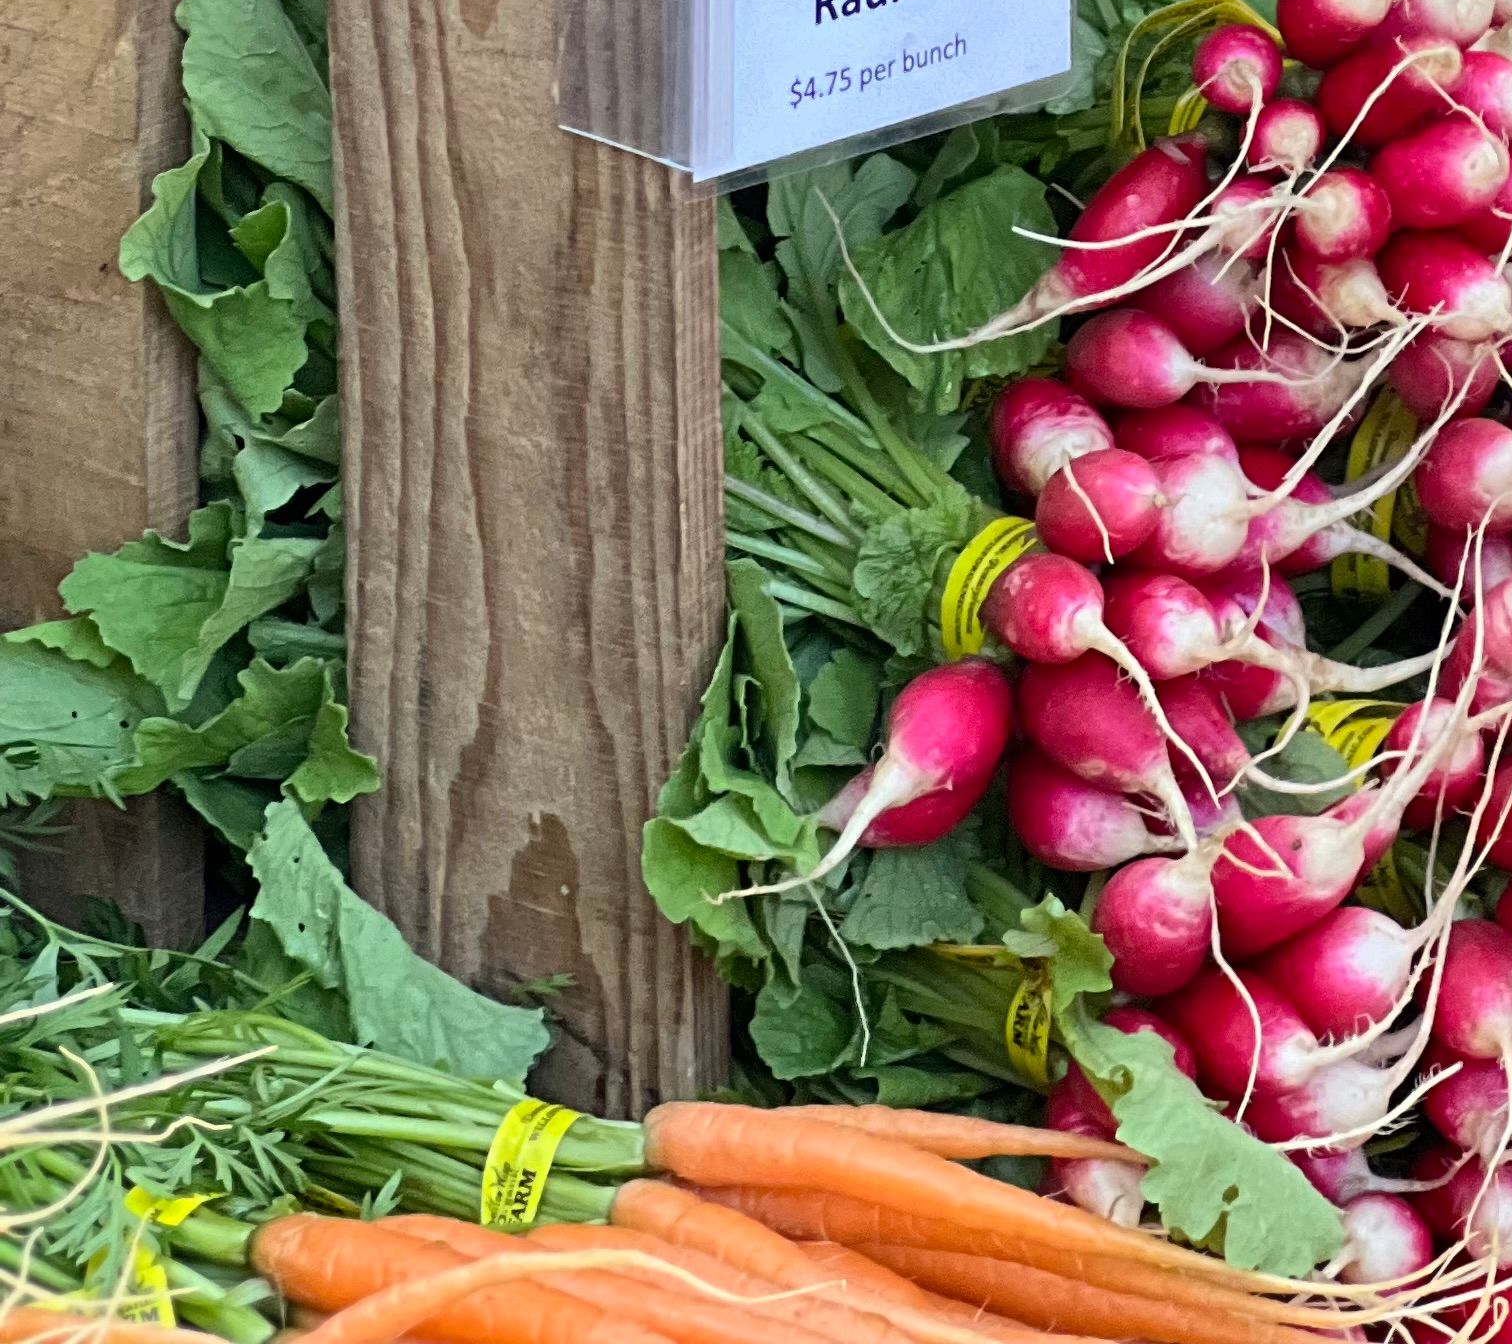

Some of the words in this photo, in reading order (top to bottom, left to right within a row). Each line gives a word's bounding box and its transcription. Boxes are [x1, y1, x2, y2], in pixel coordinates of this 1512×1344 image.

[790, 66, 852, 110] $4.75
[859, 58, 897, 92] per
[902, 32, 968, 75] bunch
